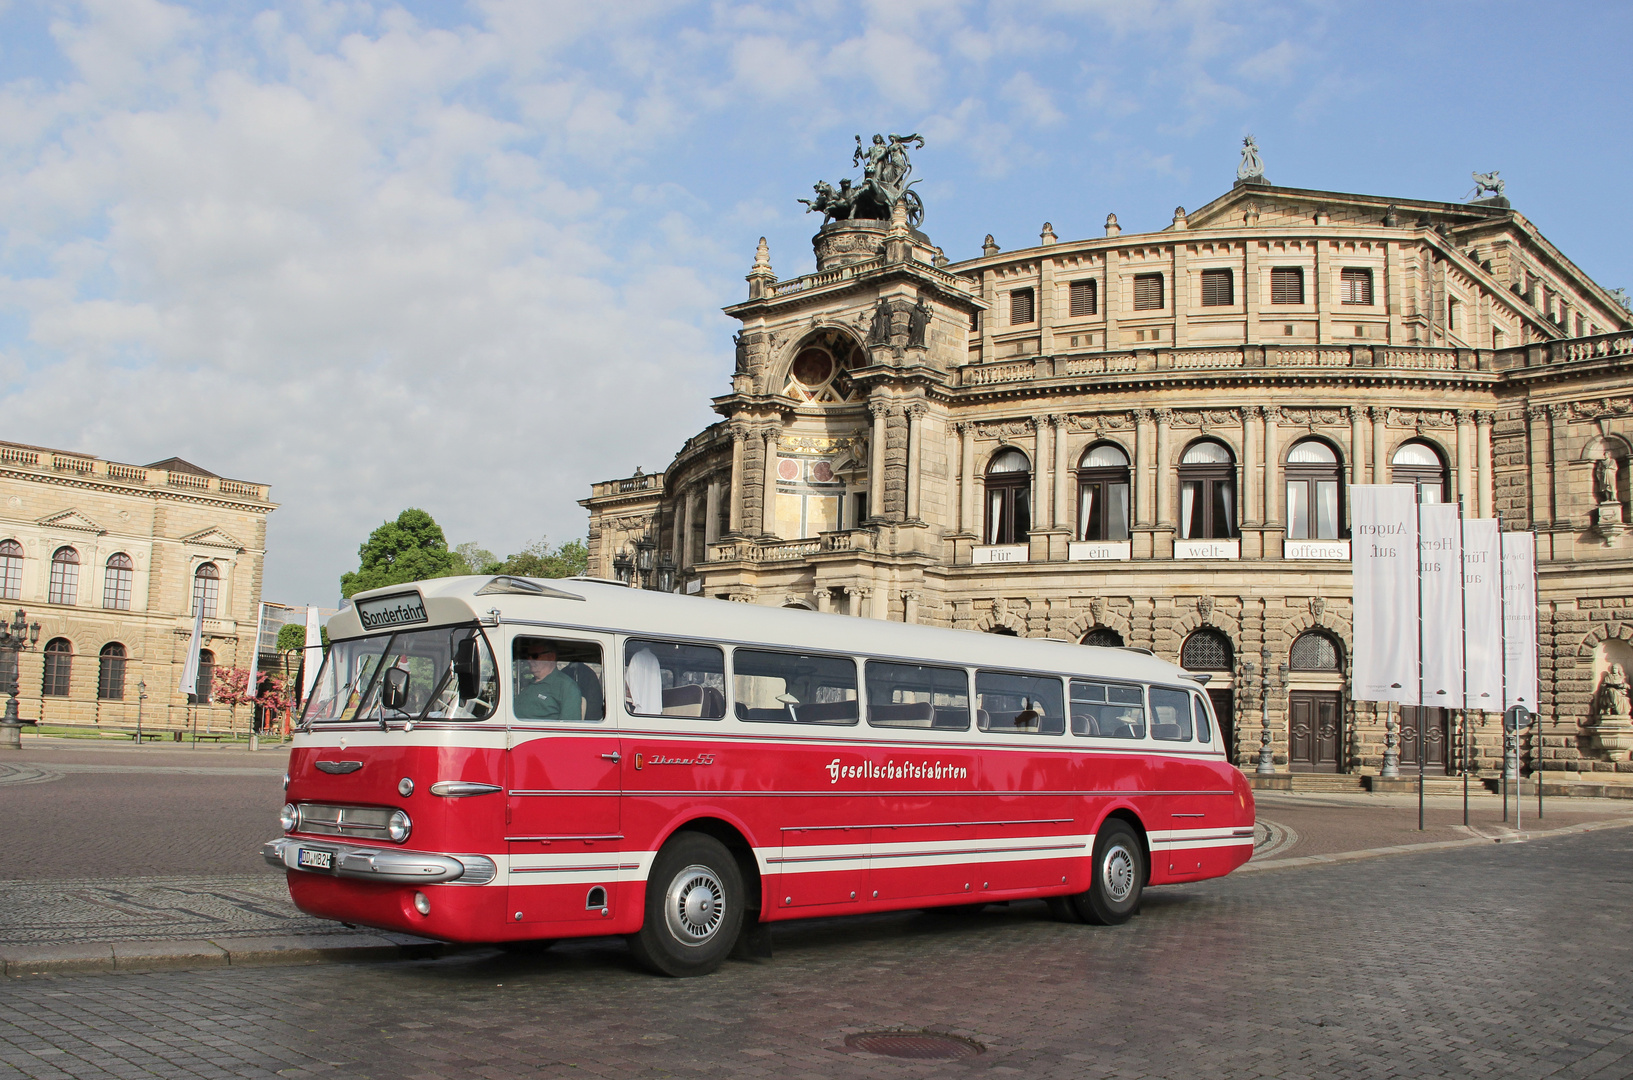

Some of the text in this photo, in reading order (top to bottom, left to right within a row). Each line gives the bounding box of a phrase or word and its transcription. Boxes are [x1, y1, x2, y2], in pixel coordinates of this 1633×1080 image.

[989, 544, 1344, 562] Für ein welt- offenes
[362, 603, 427, 626] Sonderfahrt
[648, 753, 716, 765] Ikarus 55
[825, 758, 967, 784] Gesellschaftsfahrten
